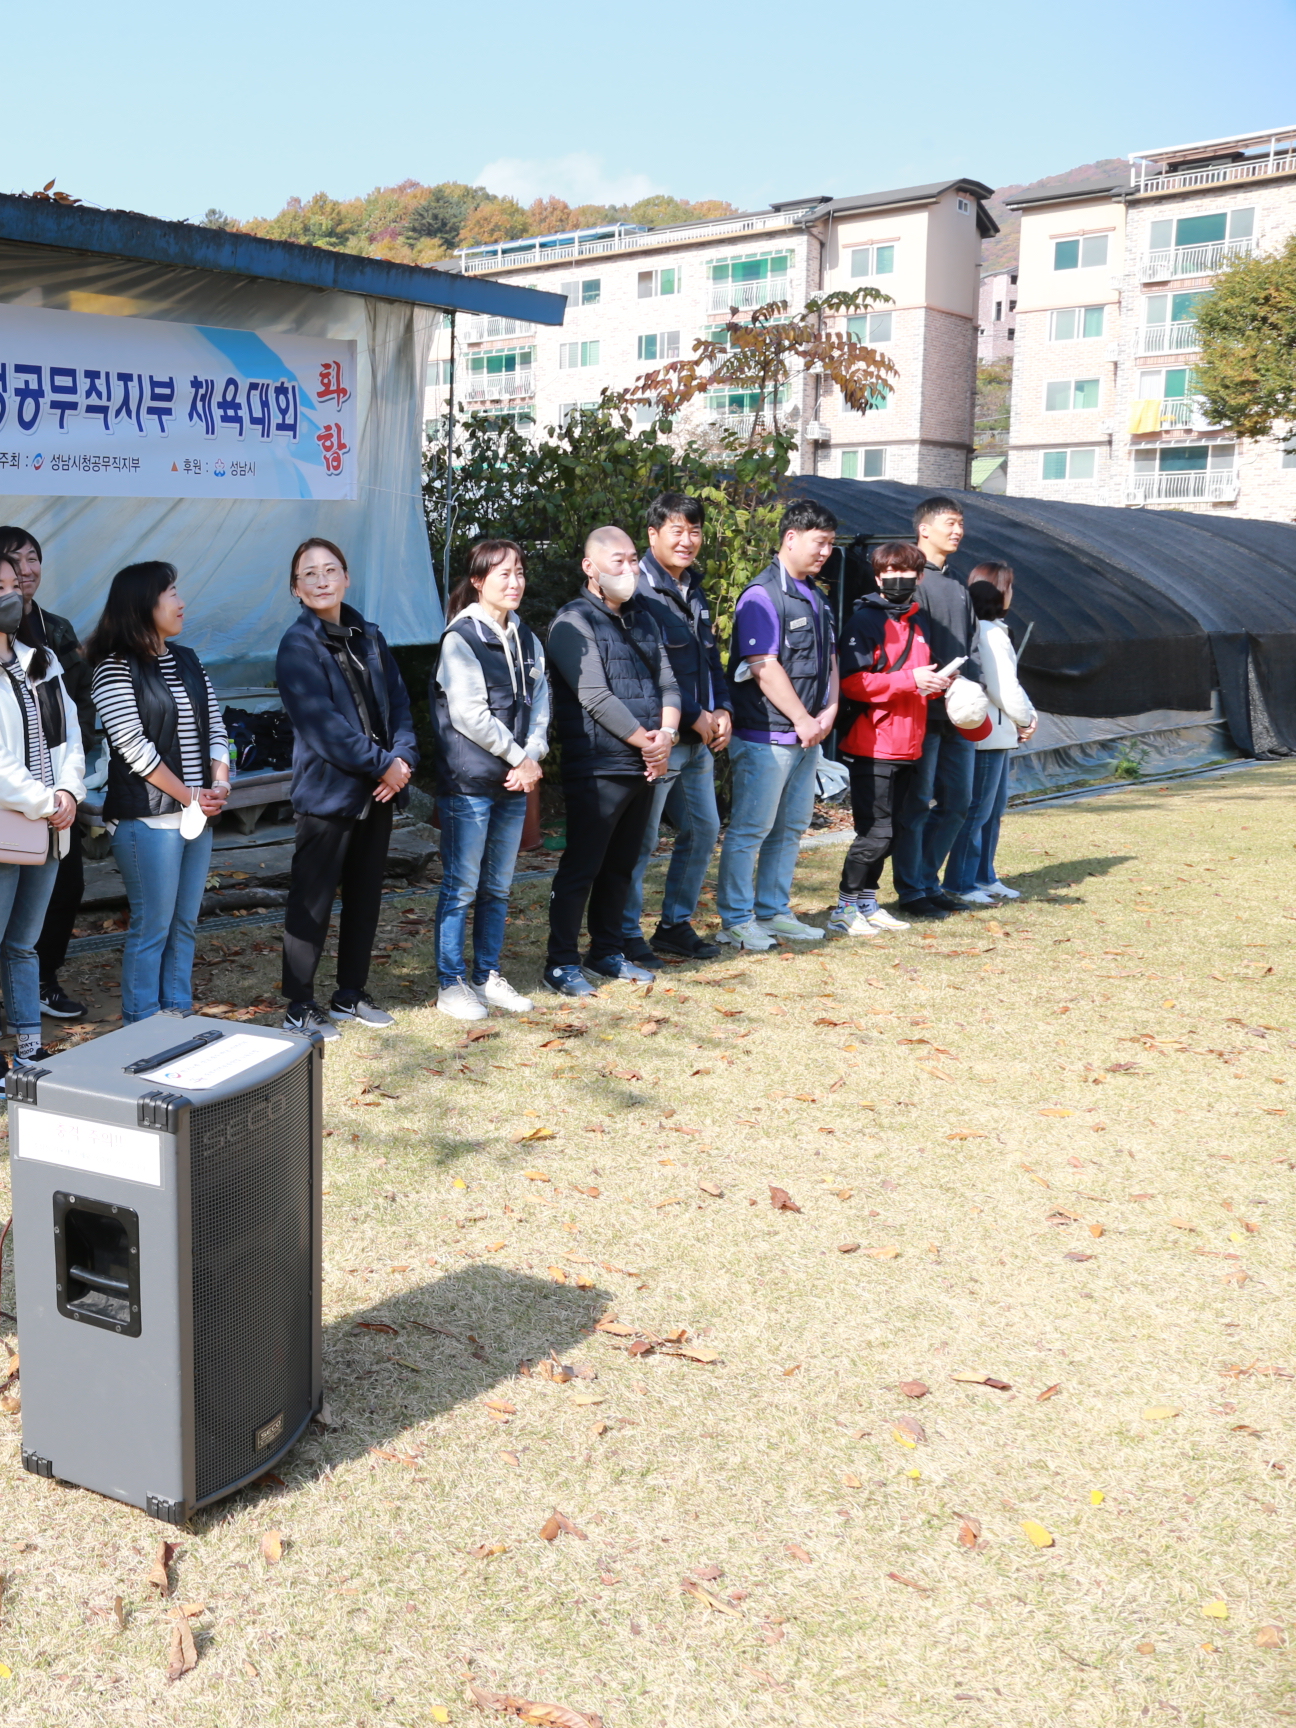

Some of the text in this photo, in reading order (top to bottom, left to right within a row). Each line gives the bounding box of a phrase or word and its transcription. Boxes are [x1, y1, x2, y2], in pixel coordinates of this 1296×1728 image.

[188, 375, 299, 441] 체육대회
[316, 359, 349, 472] 화합
[50, 454, 141, 473] 성남시청공무직지부
[183, 458, 202, 475] 후원
[230, 460, 256, 477] 성남시
[55, 1122, 123, 1148] 충격 주의!!
